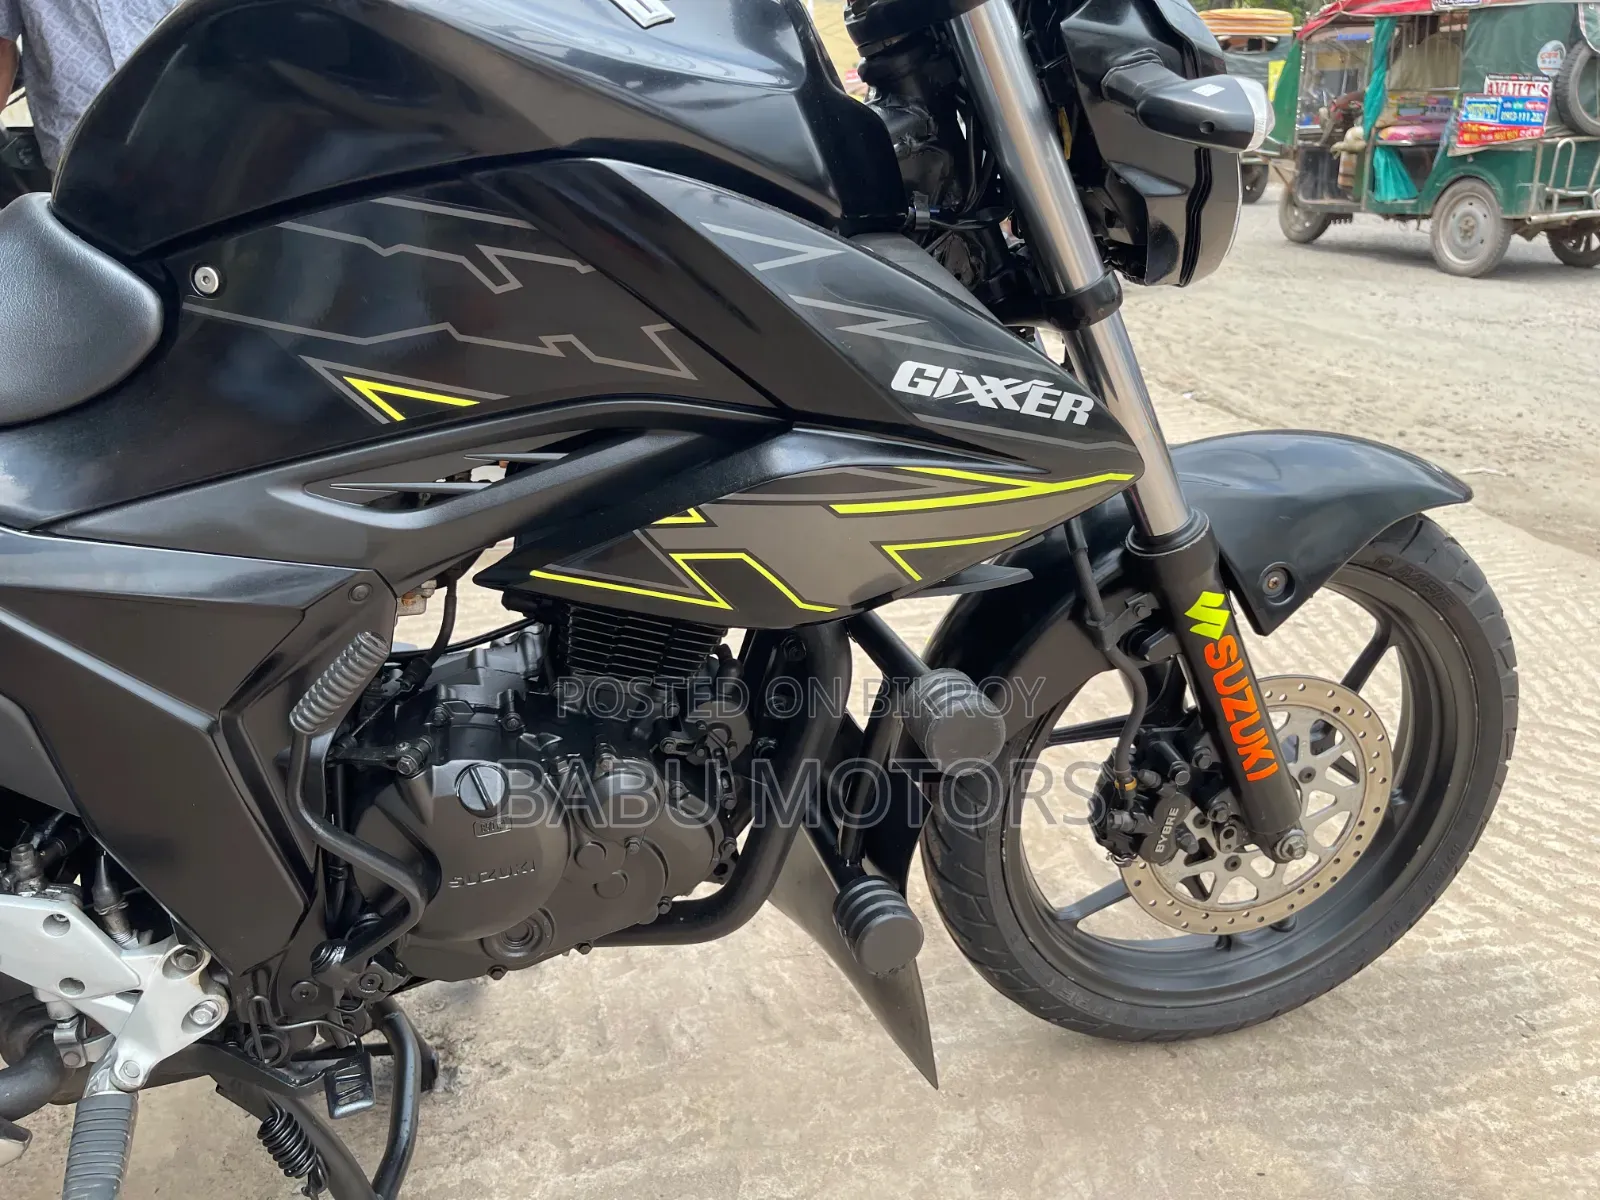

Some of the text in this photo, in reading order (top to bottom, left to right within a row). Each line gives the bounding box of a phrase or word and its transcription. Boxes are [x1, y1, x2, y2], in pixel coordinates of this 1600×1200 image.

[890, 360, 1095, 426] GIXXER
[1203, 634, 1279, 782] SUZUKI
[1154, 807, 1179, 853] BYBRE
[448, 860, 536, 888] SUZUKI
